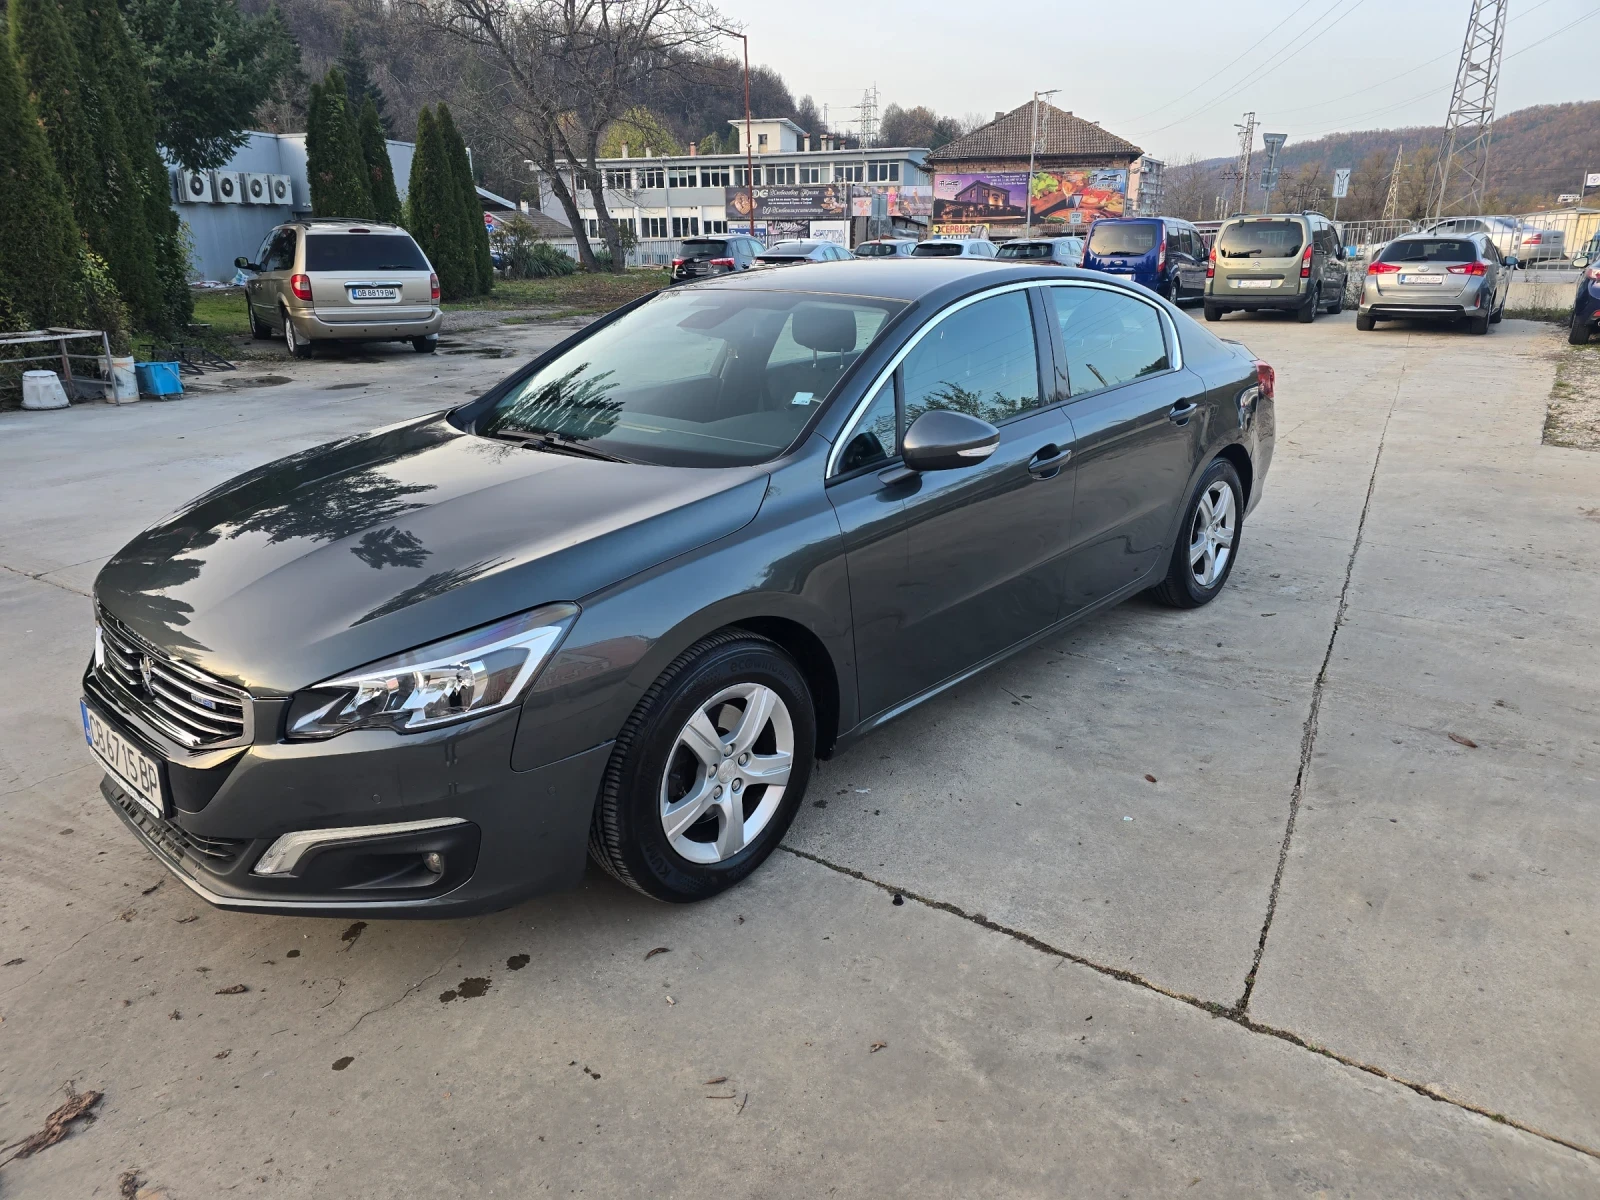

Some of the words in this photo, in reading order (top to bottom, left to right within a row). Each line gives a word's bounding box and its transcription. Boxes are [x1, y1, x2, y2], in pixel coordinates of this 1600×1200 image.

[941, 225, 969, 234] СЕРВИЗ
[367, 289, 384, 297] 8819
[106, 730, 138, 783] 6715
[138, 755, 157, 797] BP
